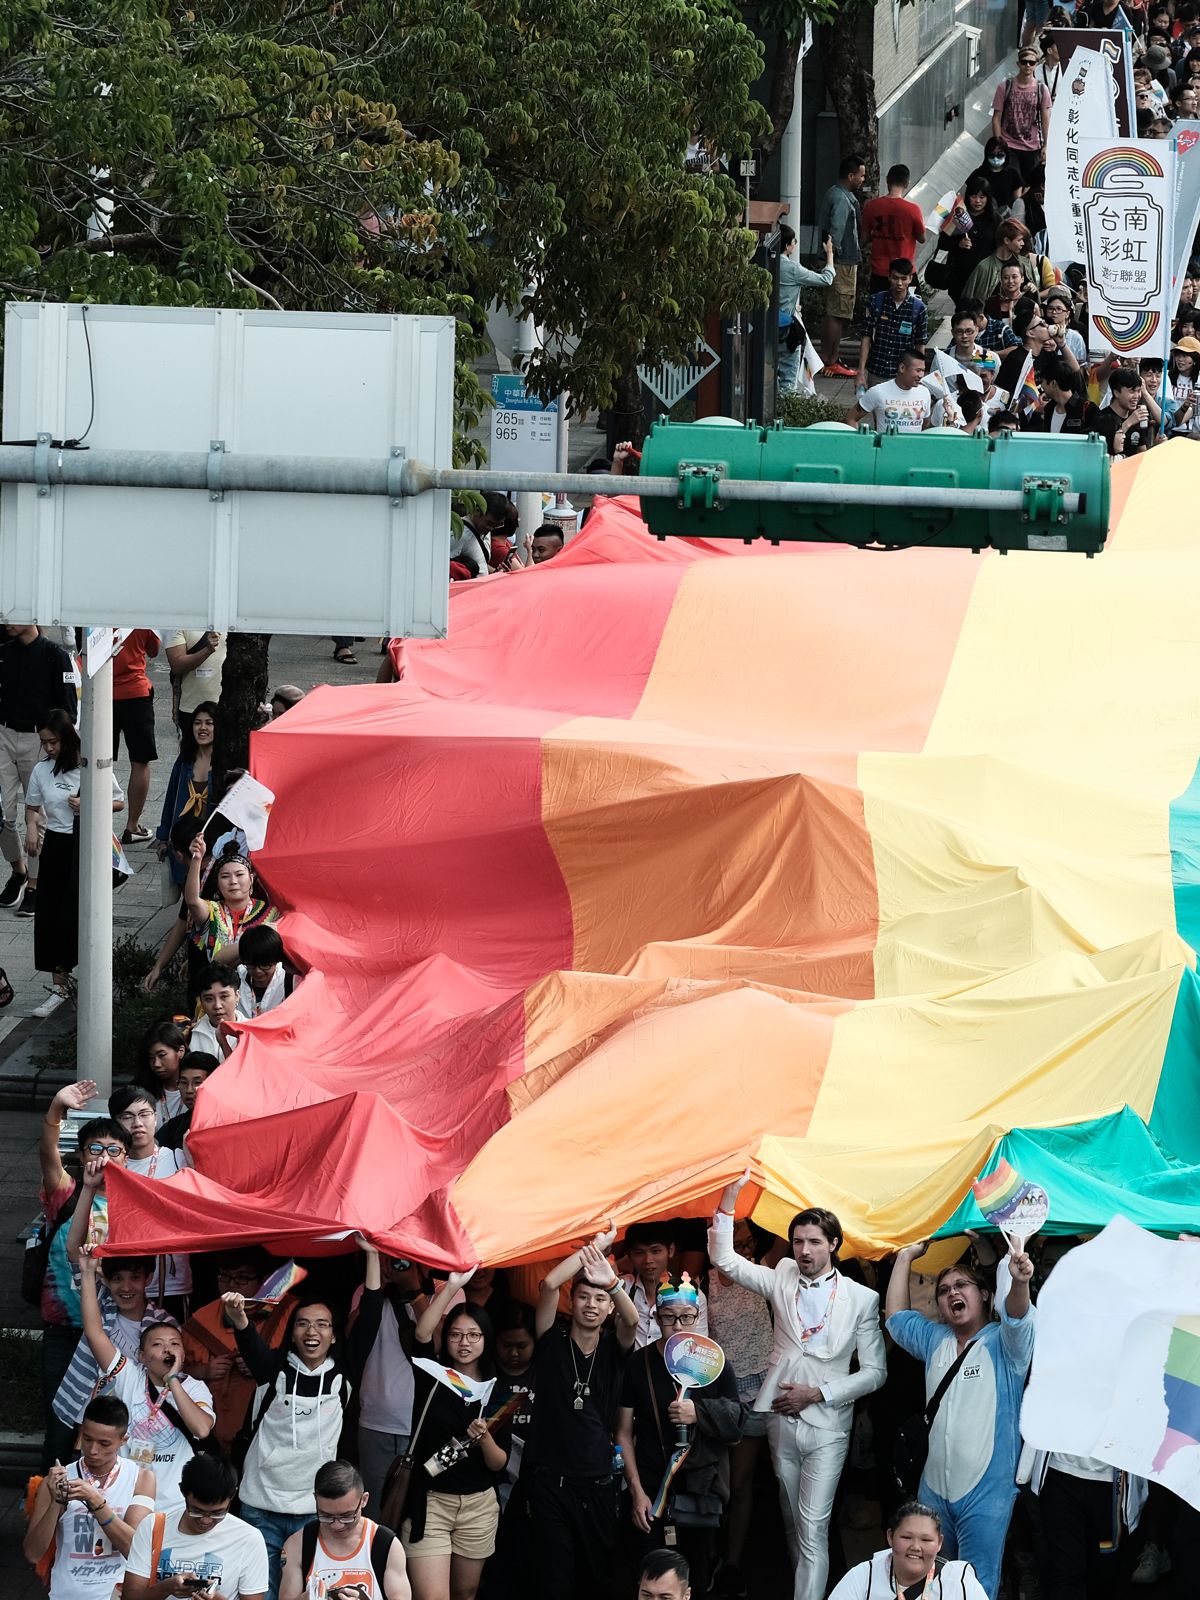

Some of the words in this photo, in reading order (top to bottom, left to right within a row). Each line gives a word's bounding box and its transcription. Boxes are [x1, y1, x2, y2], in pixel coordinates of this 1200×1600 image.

[1097, 205, 1149, 232] 台南
[1099, 236, 1148, 263] 彩虹
[885, 399, 924, 407] LEGALIZE
[496, 412, 518, 425] 265
[884, 406, 926, 420] GAY
[495, 427, 518, 440] 965
[963, 1368, 980, 1377] GAY
[69, 1563, 96, 1577] HIP
[96, 1563, 122, 1577] HOP
